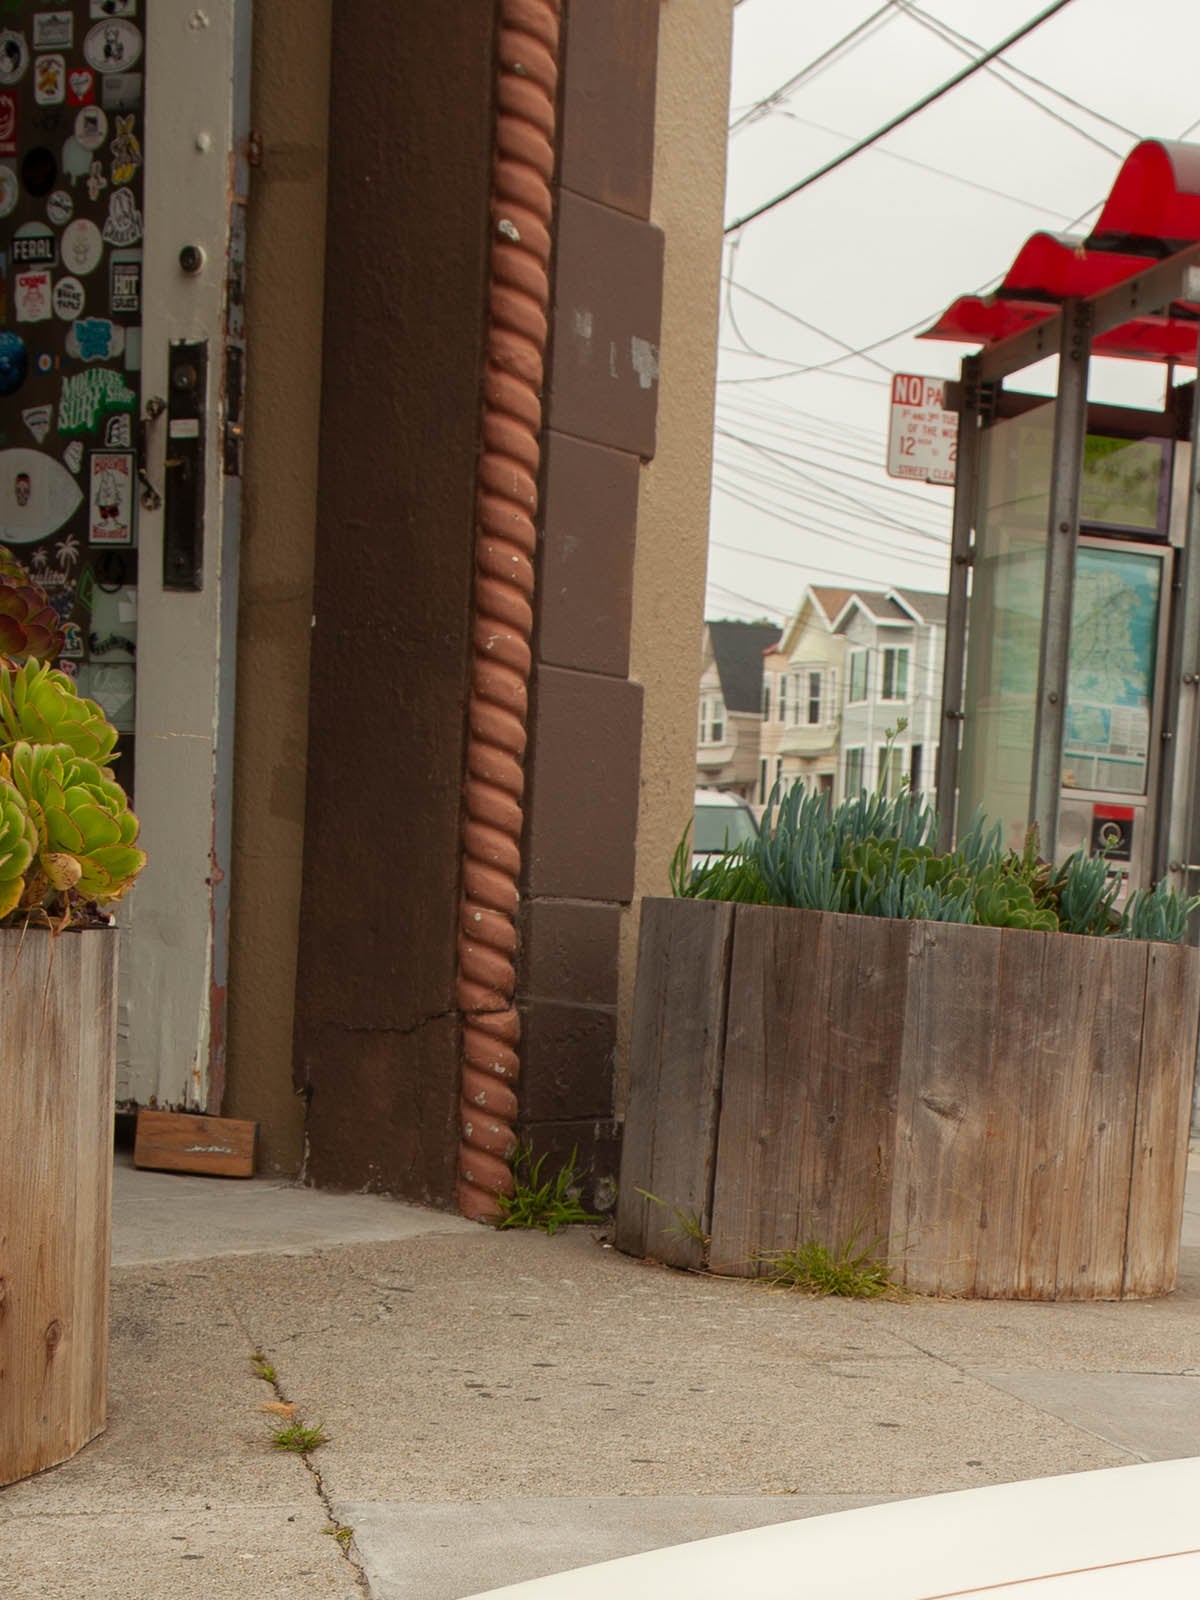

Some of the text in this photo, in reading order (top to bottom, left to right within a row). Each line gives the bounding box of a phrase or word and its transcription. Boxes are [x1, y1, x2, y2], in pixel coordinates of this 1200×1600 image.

[14, 238, 53, 261] FERAL
[894, 375, 921, 404] NO
[942, 414, 958, 426] TUE
[899, 436, 916, 456] 12
[933, 468, 955, 481] CLEA
